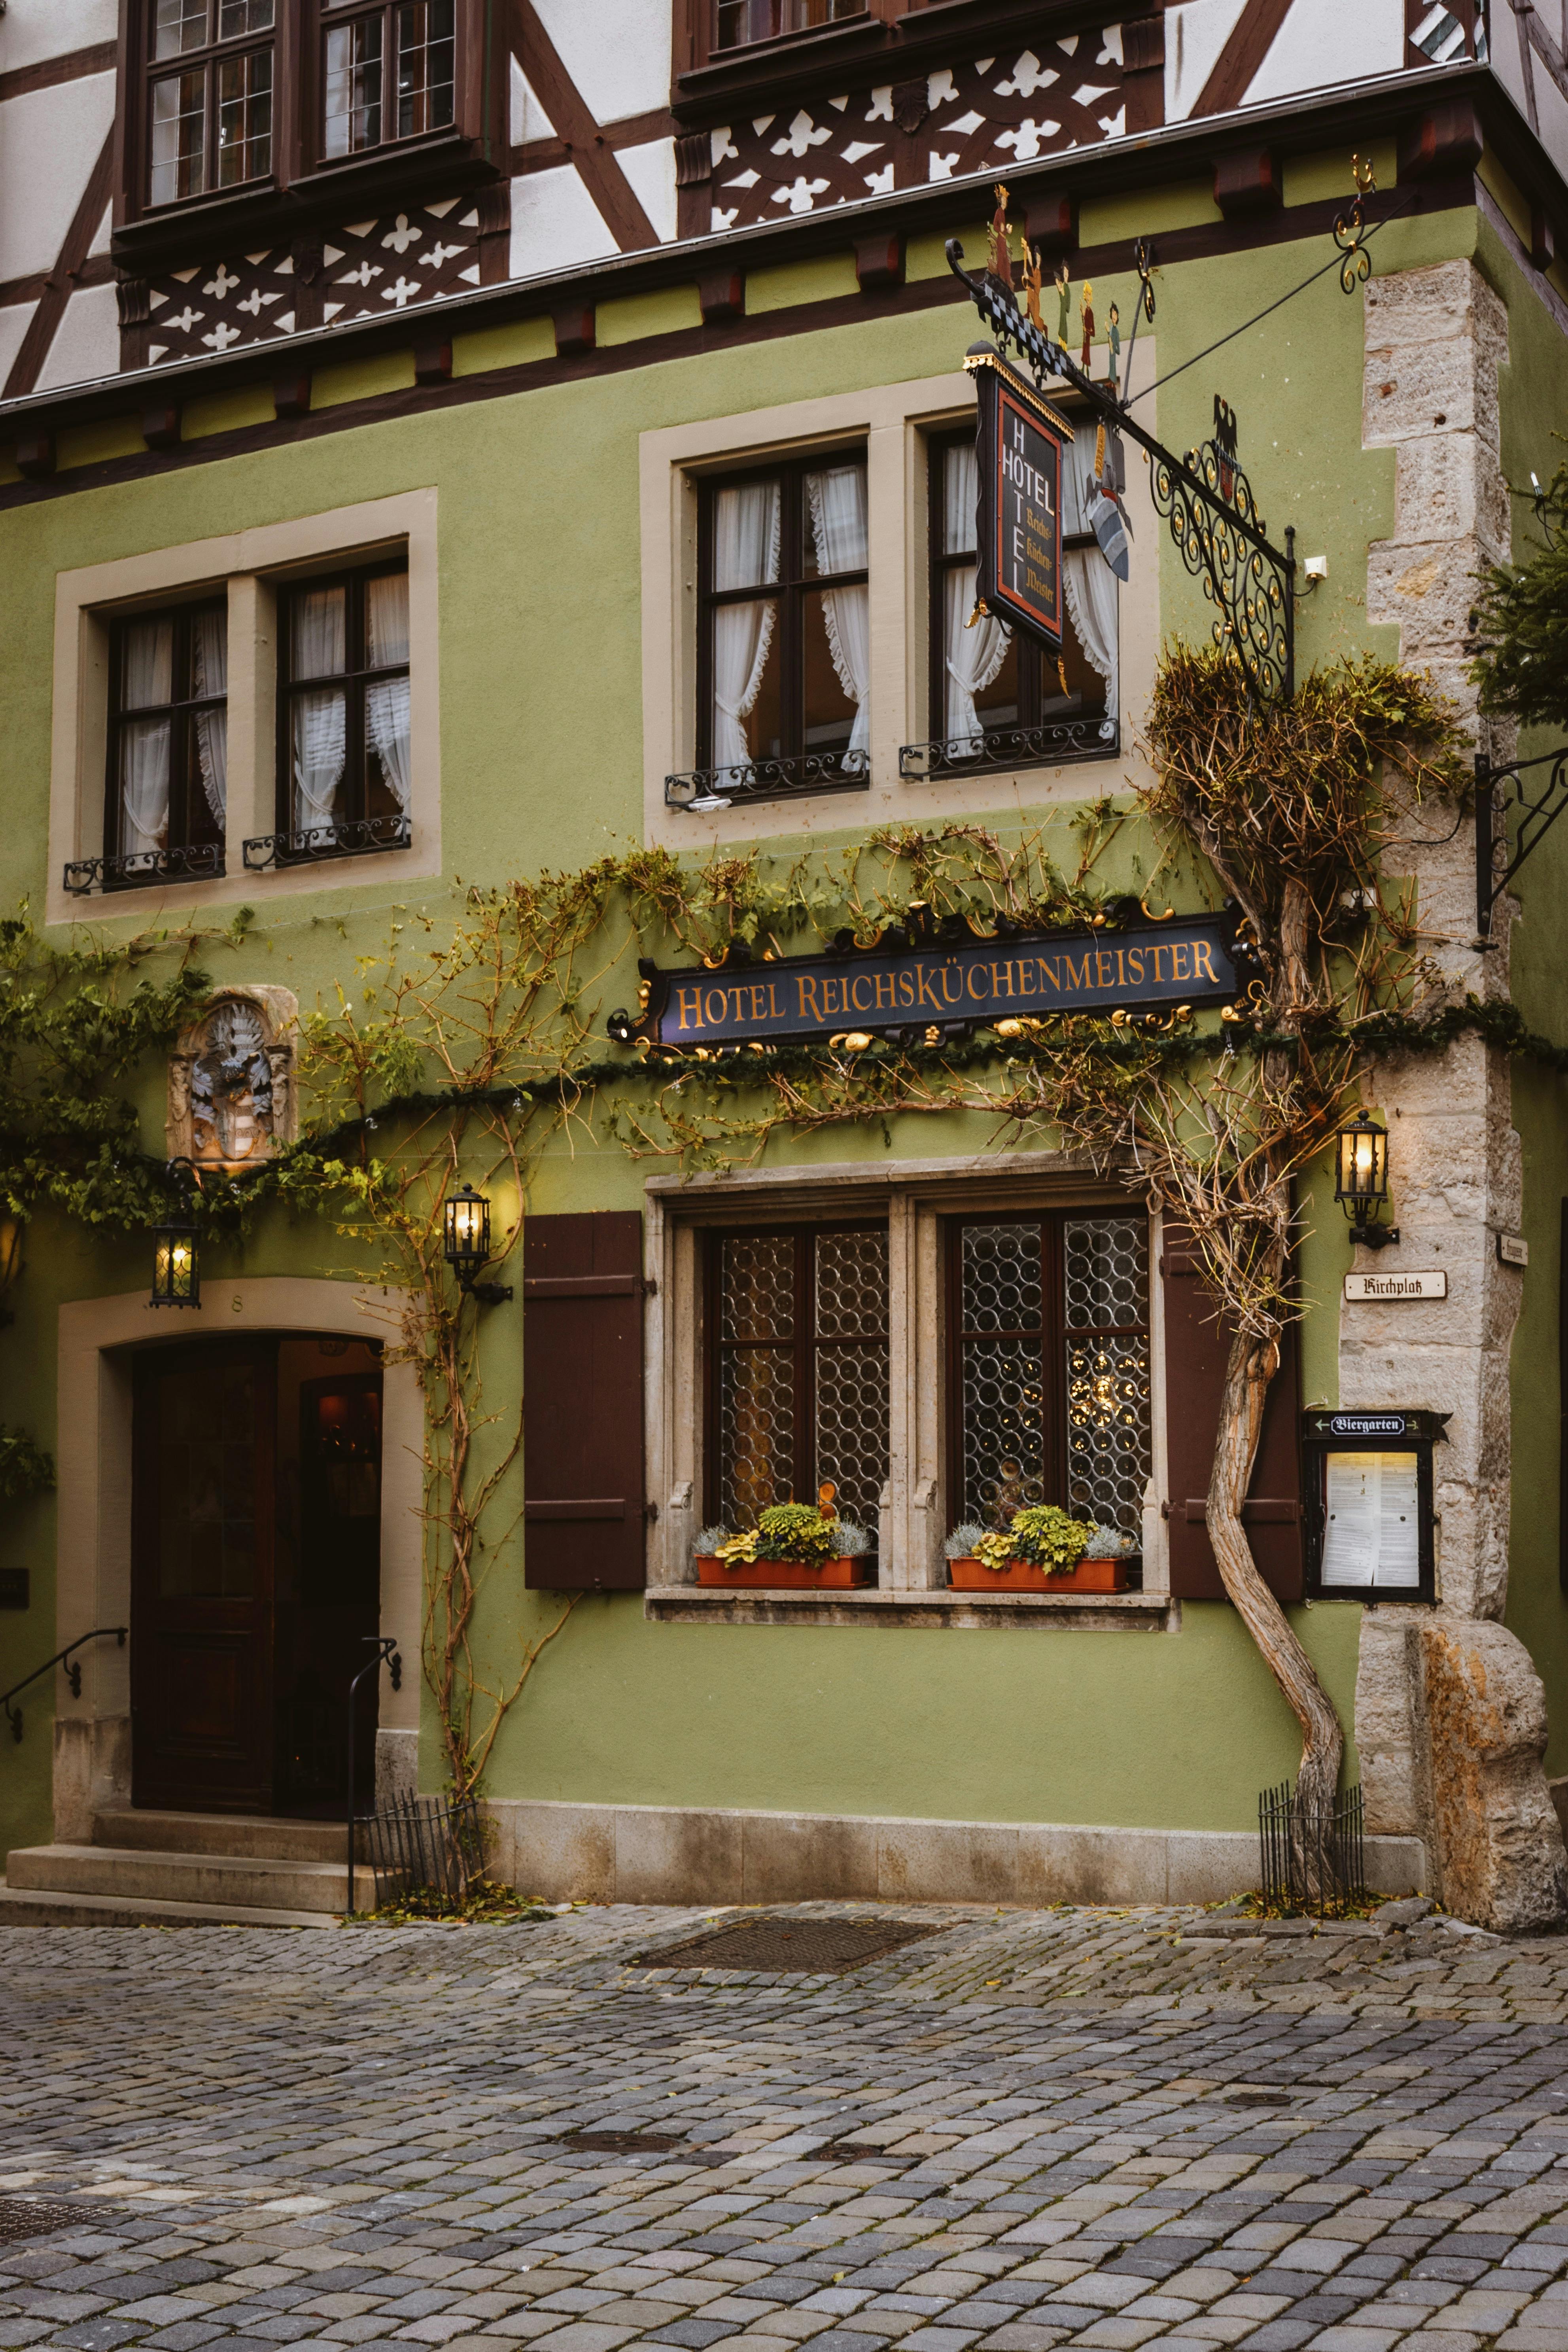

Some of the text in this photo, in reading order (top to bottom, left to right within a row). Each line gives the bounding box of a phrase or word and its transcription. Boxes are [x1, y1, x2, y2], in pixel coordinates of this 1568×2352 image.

[1002, 443, 1055, 517] HOTEL
[1026, 567, 1054, 604] Meister
[676, 984, 786, 1029] HOTEL
[1363, 1278, 1422, 1296] Kirchplatz
[232, 1294, 243, 1313] 8
[1335, 1418, 1399, 1433] Biergarten
